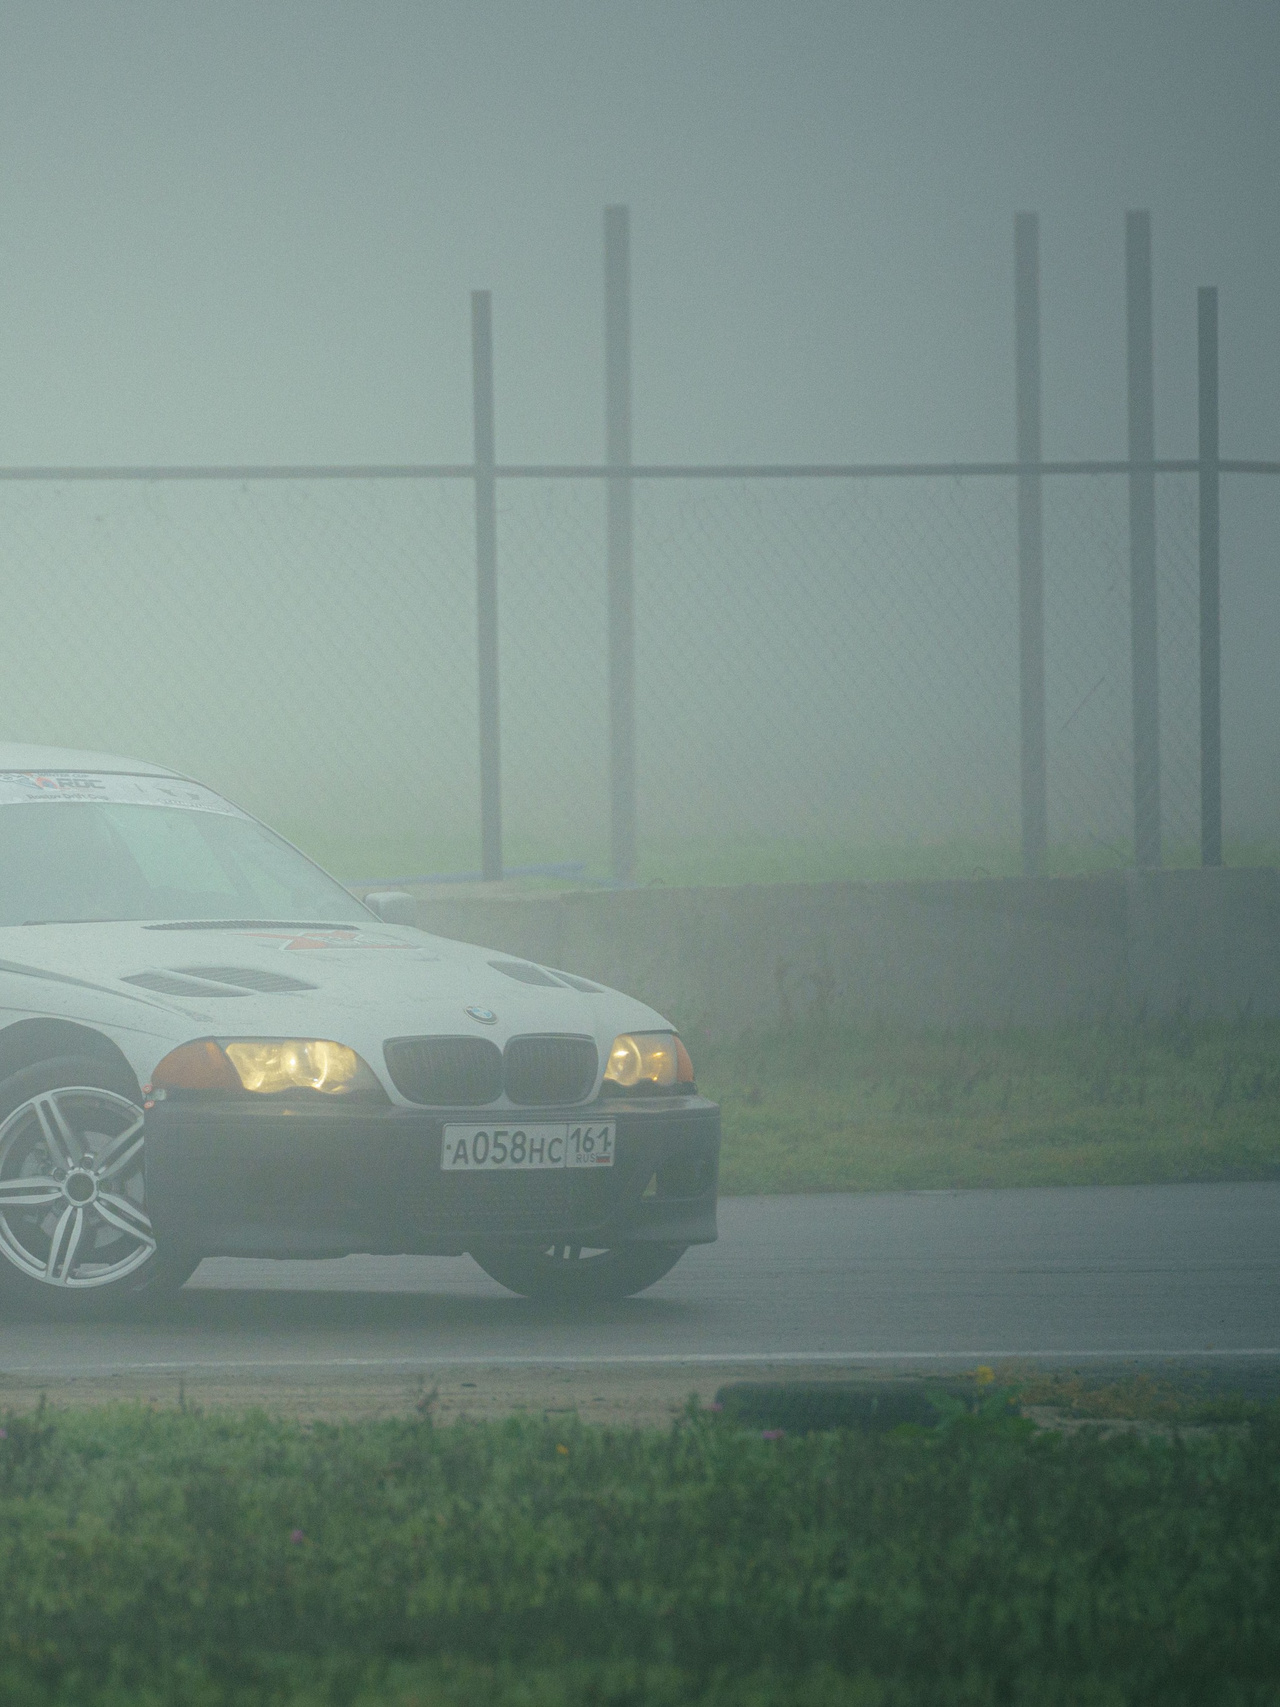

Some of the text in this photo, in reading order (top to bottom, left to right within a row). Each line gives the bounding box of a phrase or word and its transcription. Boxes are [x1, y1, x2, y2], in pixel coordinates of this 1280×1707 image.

[56, 778, 106, 789] RDC
[569, 1126, 610, 1153] 161
[576, 1153, 597, 1163] RUS
